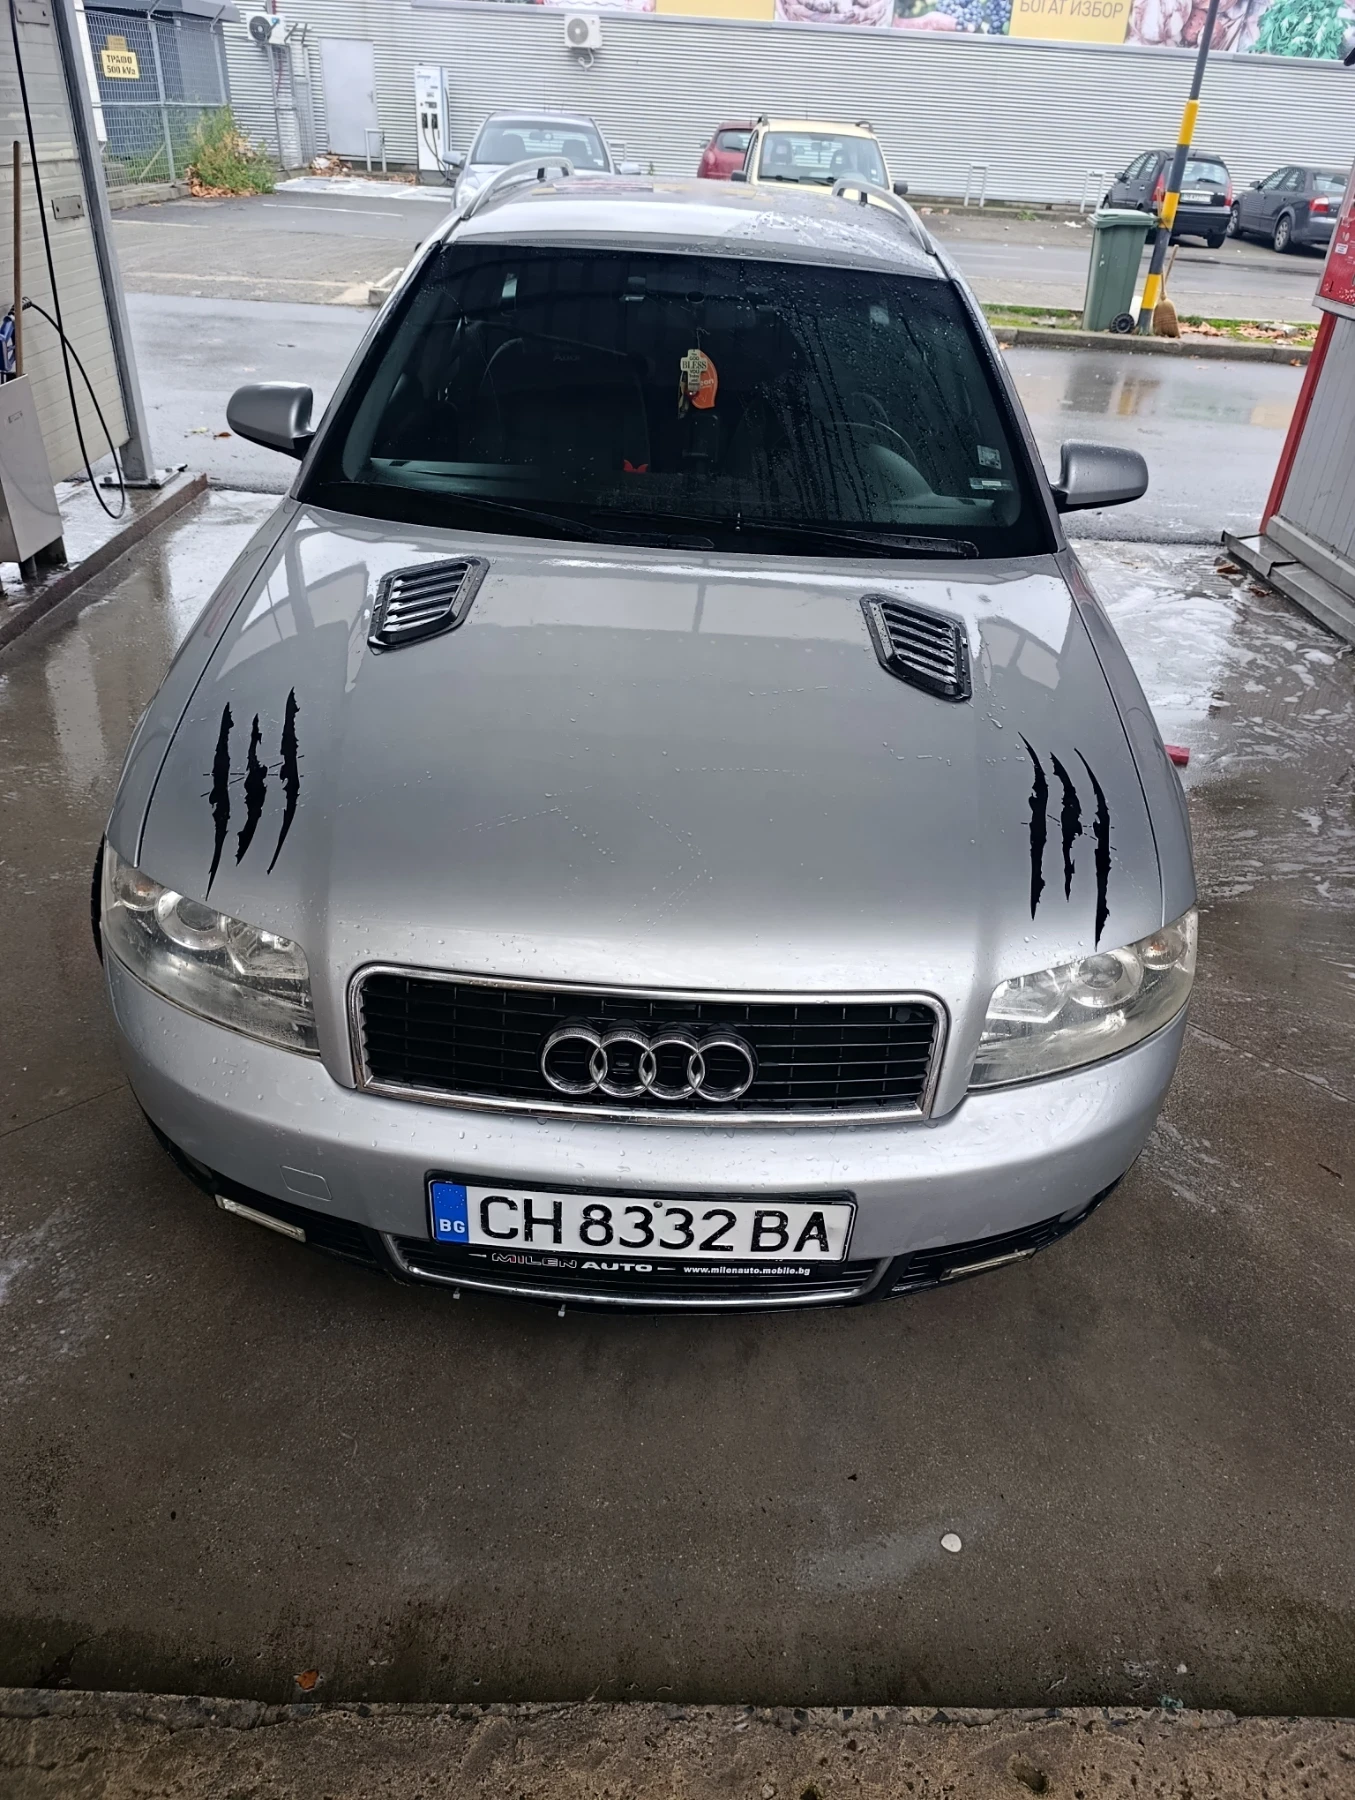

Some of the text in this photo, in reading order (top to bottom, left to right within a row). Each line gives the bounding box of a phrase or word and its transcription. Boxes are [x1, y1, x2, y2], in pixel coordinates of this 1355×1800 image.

[1019, 0, 1125, 18] БОГАТ ИЗБОР
[682, 360, 707, 369] BLESS
[439, 1218, 466, 1234] BG
[480, 1195, 830, 1252] CH 8332 BA
[491, 1252, 811, 1276] MILEN AUTO www.milenauto.mobile.bg
